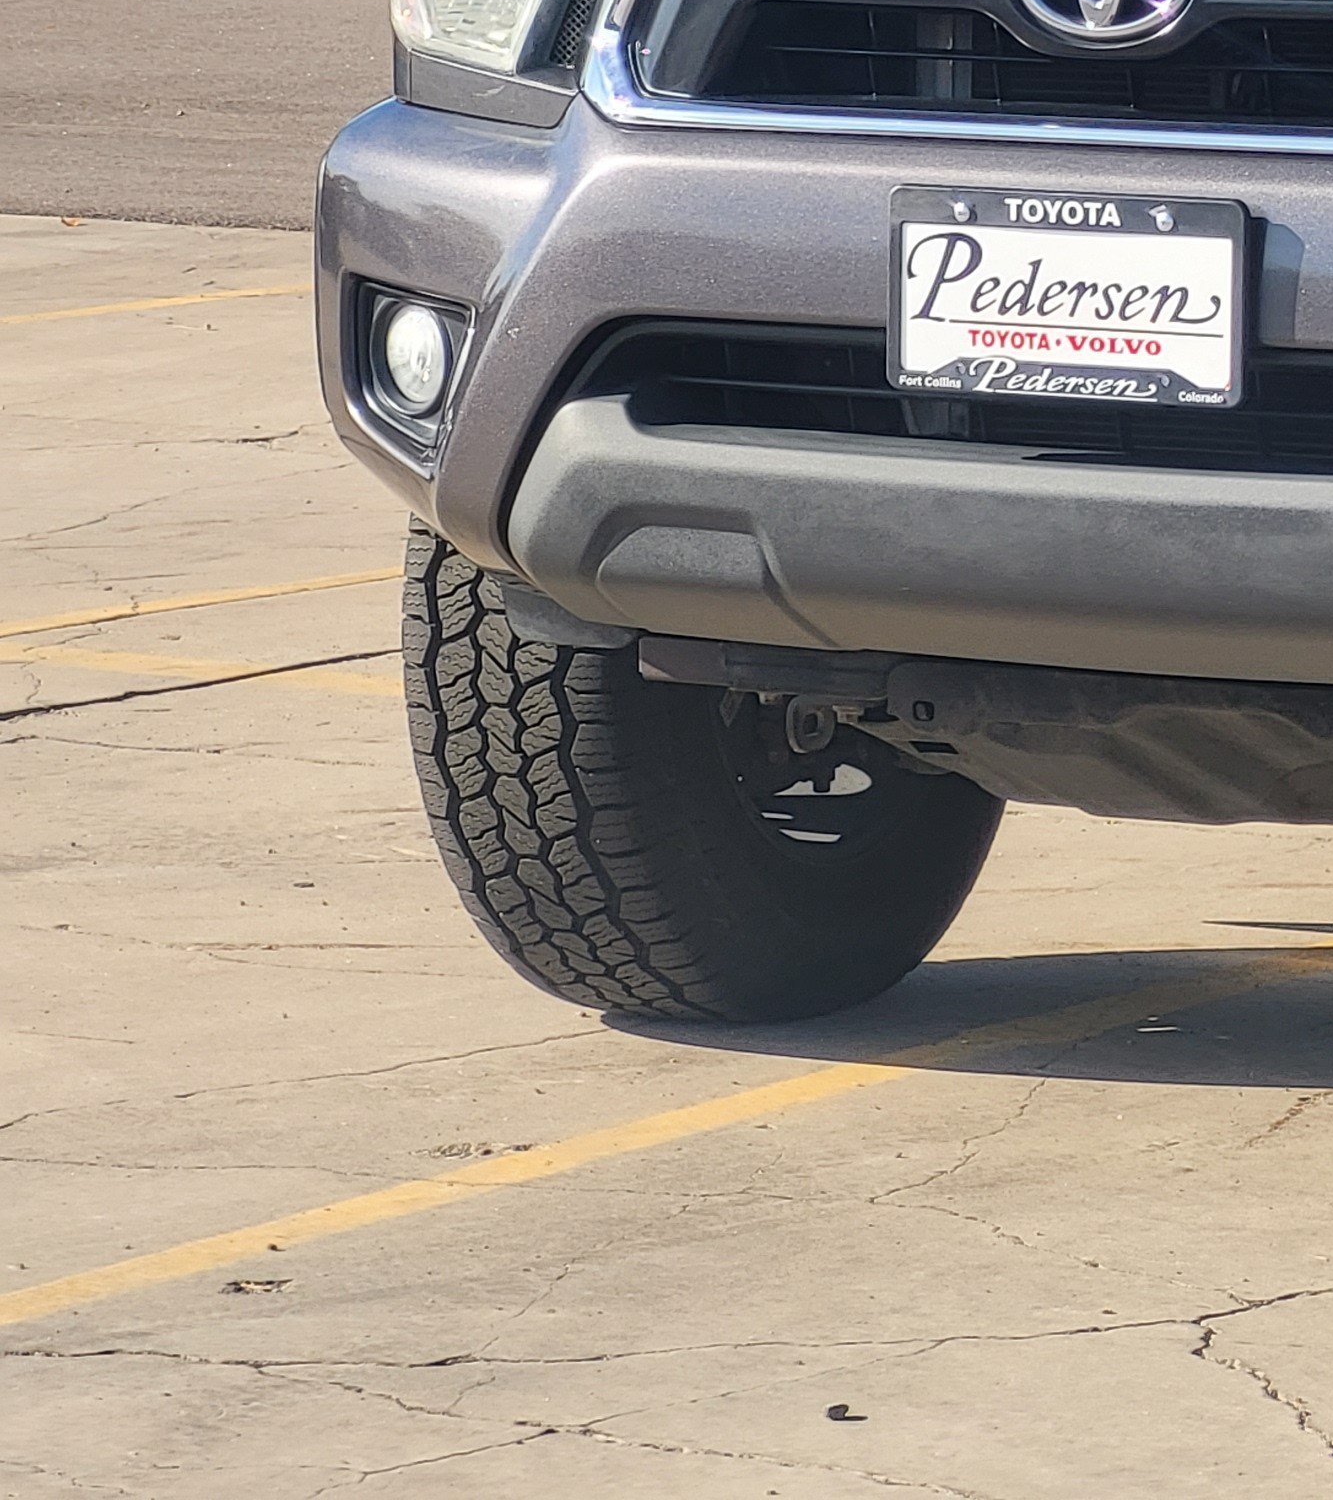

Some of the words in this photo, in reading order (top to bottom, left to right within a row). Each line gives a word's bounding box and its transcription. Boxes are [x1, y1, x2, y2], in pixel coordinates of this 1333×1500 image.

[1004, 198, 1122, 227] TOYOTA
[907, 232, 1221, 324] Pedersen
[1065, 335, 1162, 356] VOLVO
[898, 374, 923, 387] Fort
[924, 375, 962, 389] Collins
[968, 356, 1158, 398] Pedersen
[1177, 390, 1225, 404] Colorado
